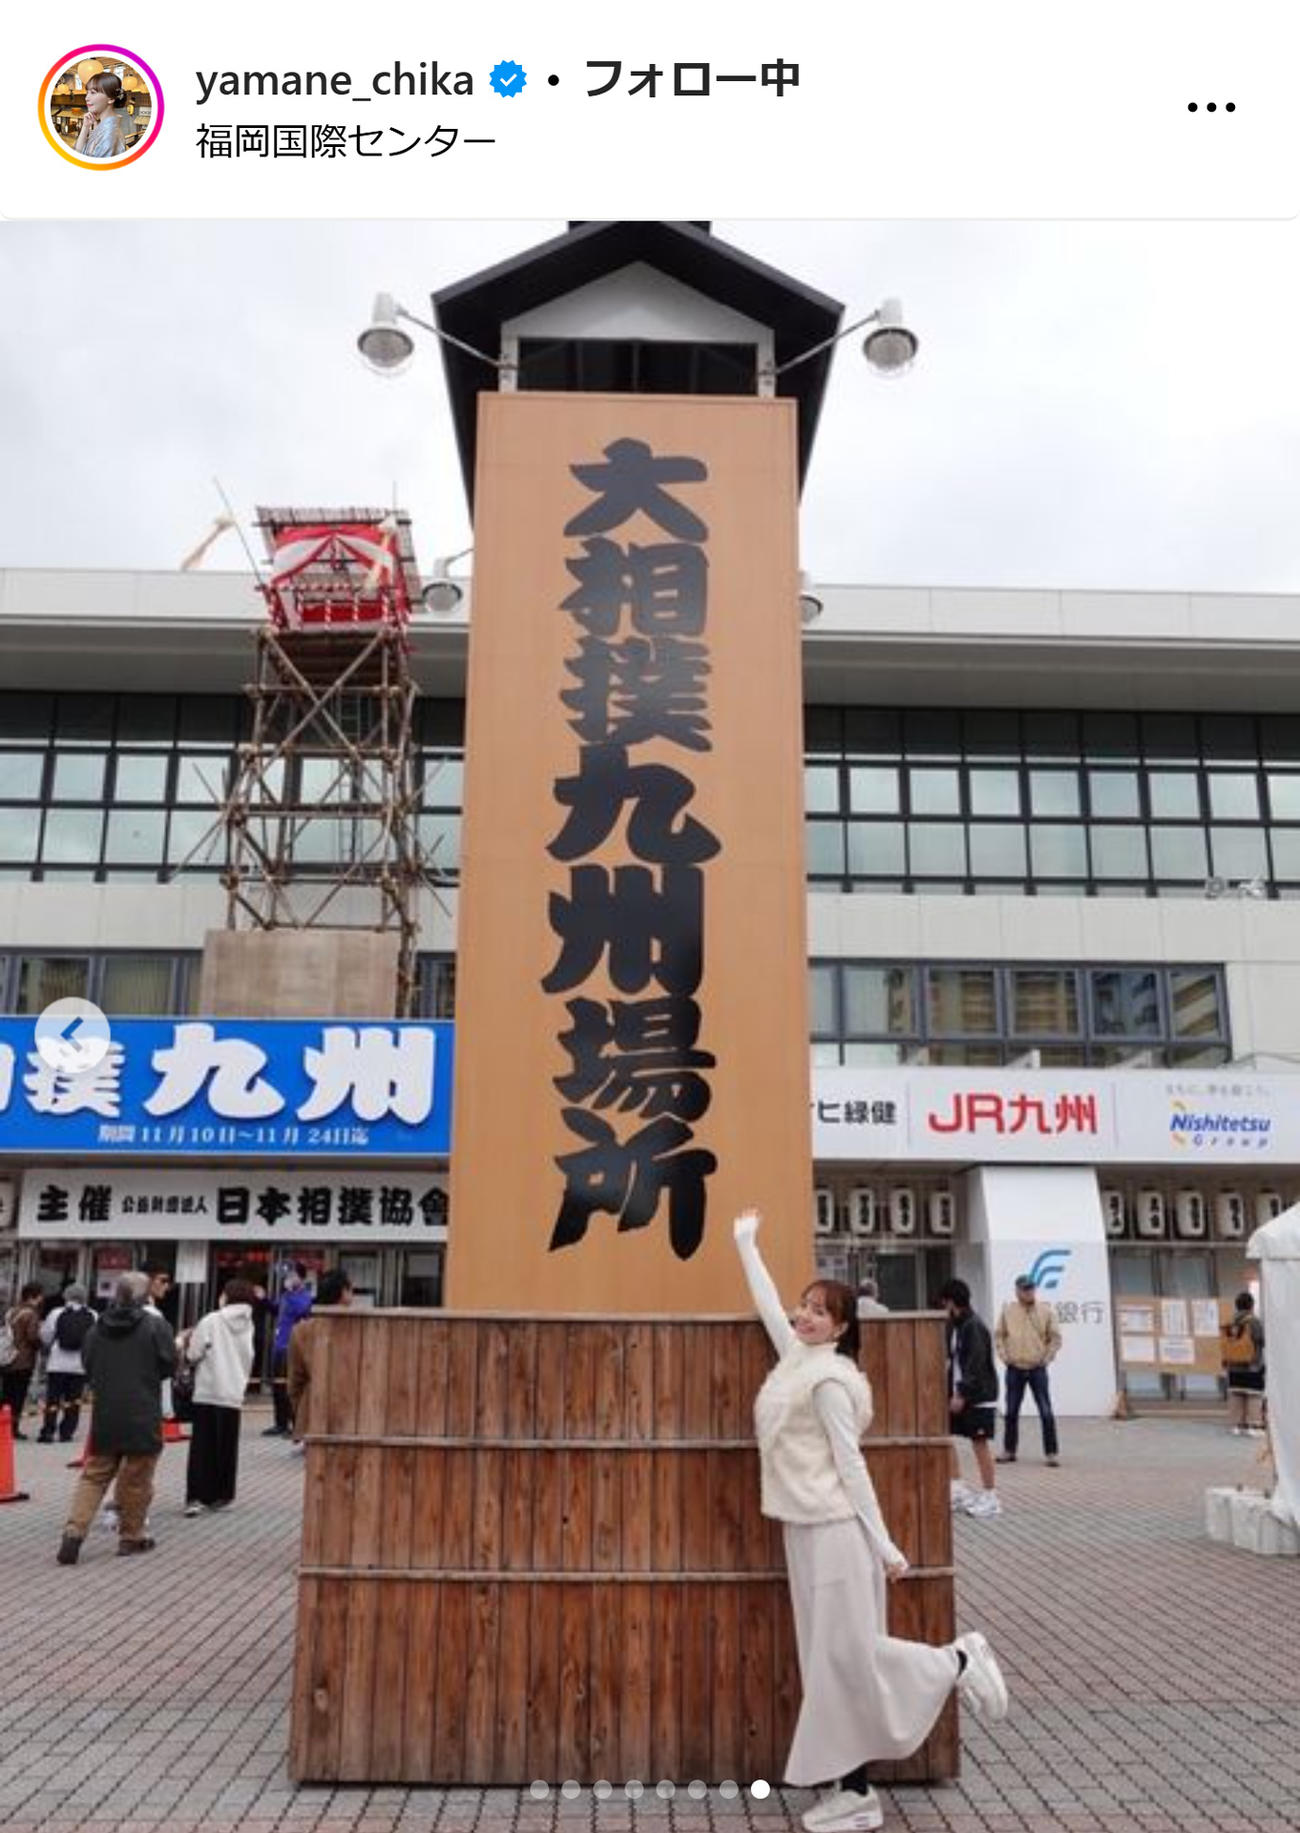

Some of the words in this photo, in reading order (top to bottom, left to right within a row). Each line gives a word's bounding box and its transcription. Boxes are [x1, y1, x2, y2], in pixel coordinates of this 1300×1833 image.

[541, 438, 721, 1261] 大相撲九州場所
[810, 1100, 896, 1124] ヒ緑健
[929, 1093, 1098, 1135] JR九州
[1170, 1113, 1271, 1132] Nishitetsu
[37, 1185, 112, 1222] 主催
[1040, 1301, 1104, 1323] 銀行
